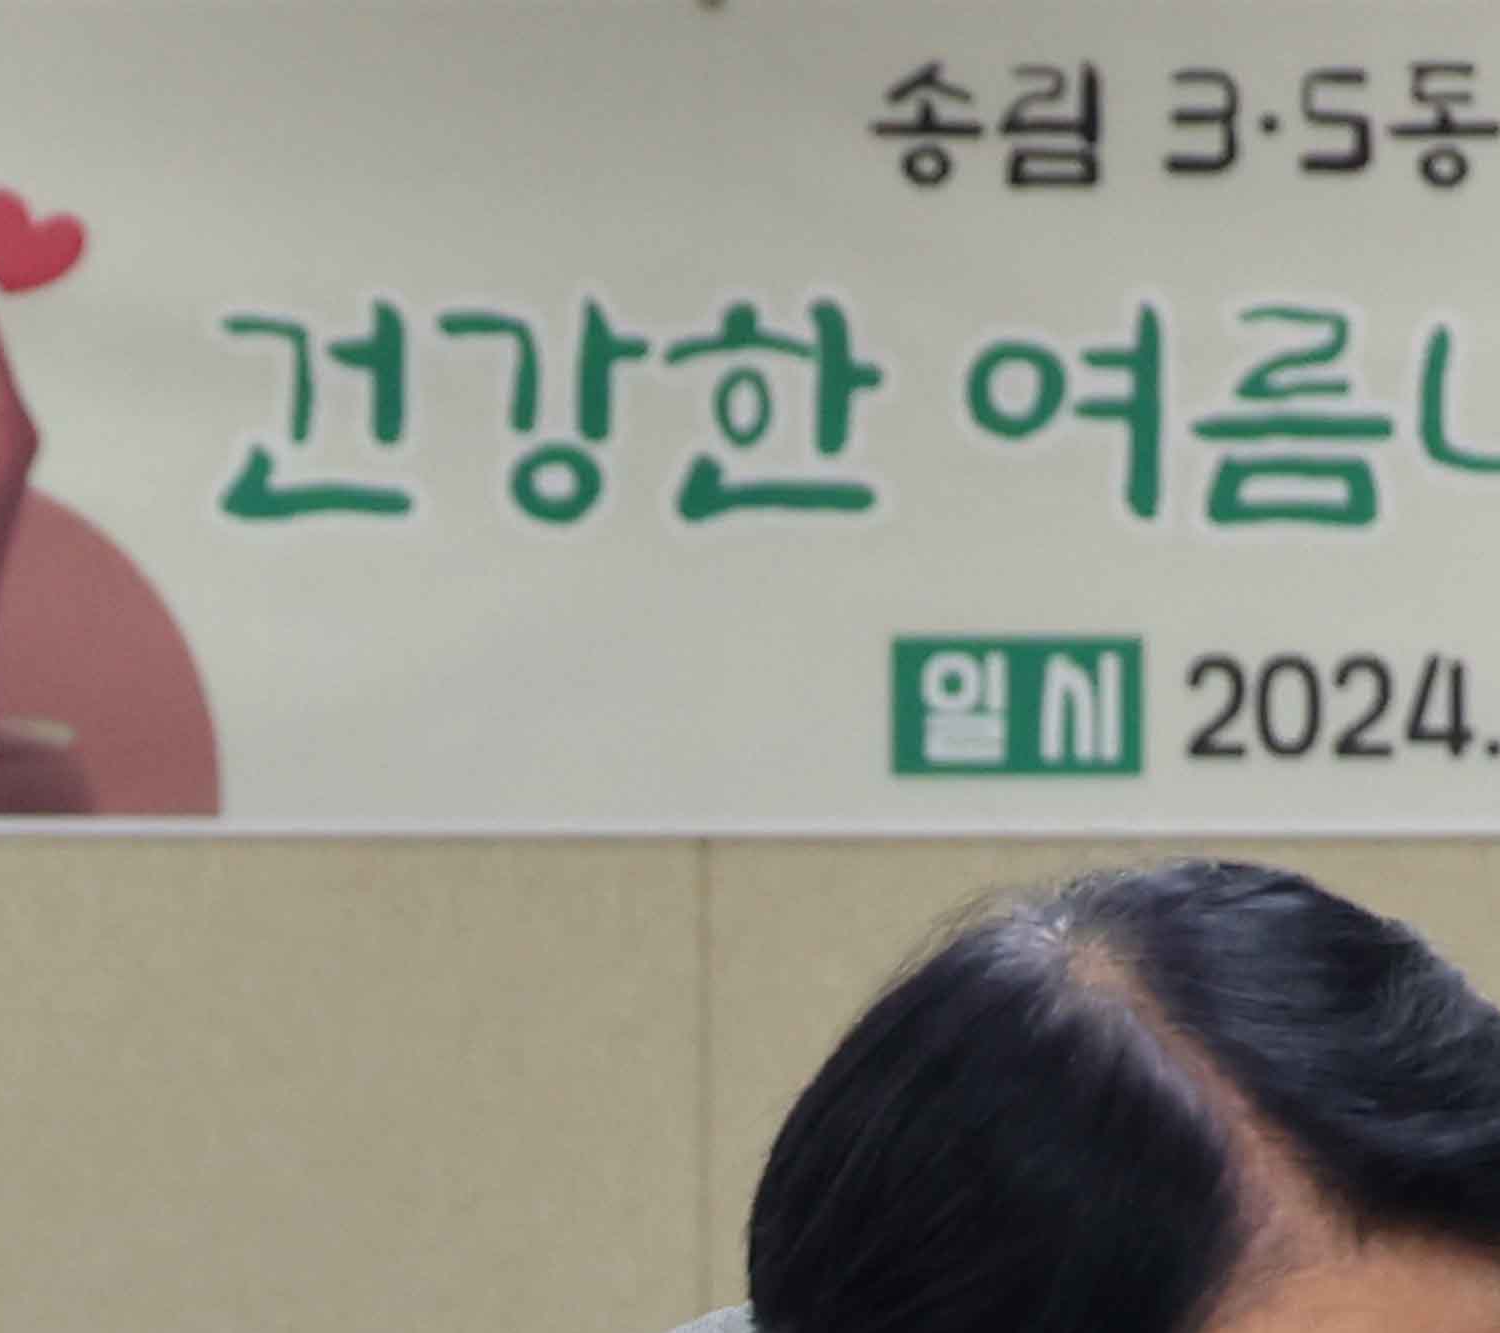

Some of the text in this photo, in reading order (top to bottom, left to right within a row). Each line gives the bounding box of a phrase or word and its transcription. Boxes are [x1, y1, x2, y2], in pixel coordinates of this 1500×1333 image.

[871, 60, 1102, 189] 송림
[1164, 60, 1500, 188] 3·5동
[219, 298, 884, 524] 건강한
[920, 650, 1123, 762] 일시
[1186, 653, 1500, 760] 2024.
